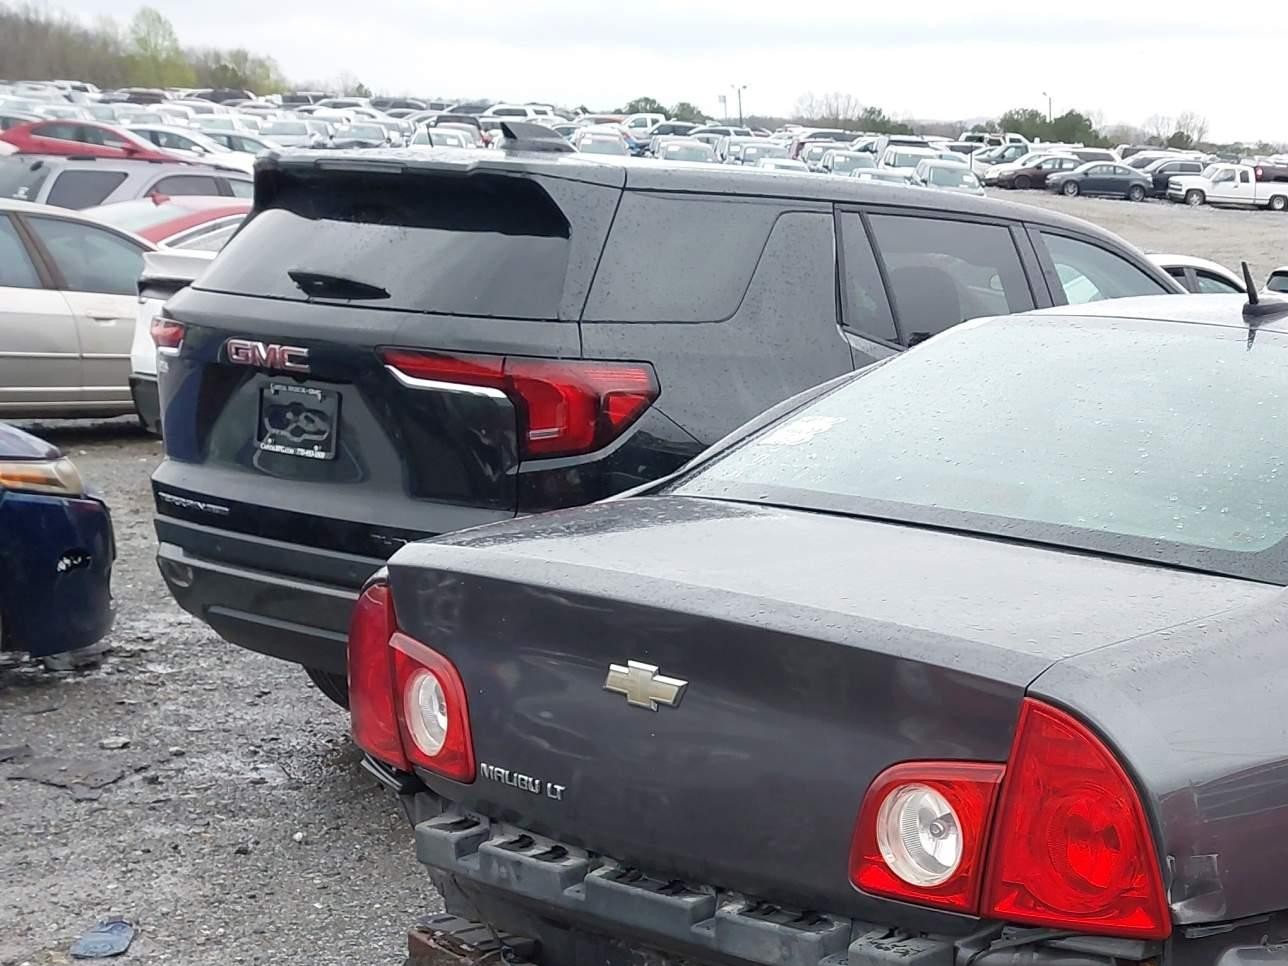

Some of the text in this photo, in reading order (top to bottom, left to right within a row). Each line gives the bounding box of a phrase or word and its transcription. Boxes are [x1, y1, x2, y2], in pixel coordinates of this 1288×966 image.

[227, 338, 312, 373] GMC
[480, 762, 566, 801] MALIBU LT
